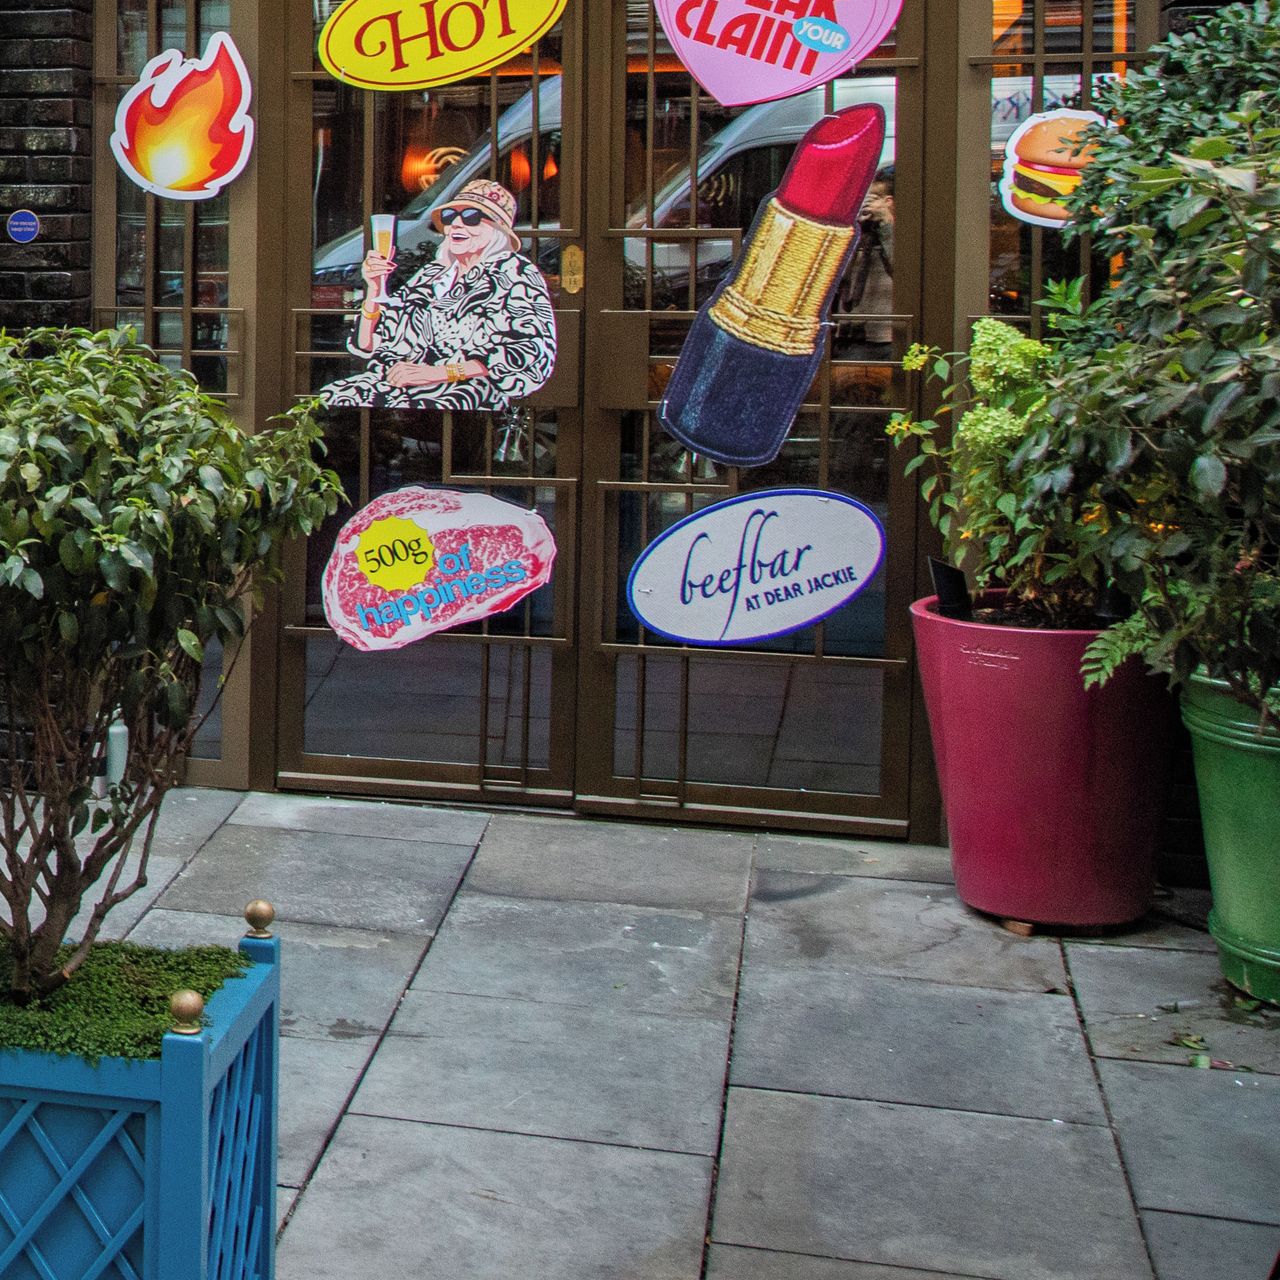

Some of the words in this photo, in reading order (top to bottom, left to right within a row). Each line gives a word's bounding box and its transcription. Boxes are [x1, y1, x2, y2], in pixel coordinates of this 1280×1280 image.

[798, 21, 845, 50] YOUR
[364, 537, 429, 573] 500g
[439, 543, 472, 575] of
[680, 508, 813, 641] beefbar
[356, 559, 527, 630] happiness
[745, 594, 761, 611] AT
[763, 583, 804, 606] DEAR
[806, 566, 857, 594] JACKIE
